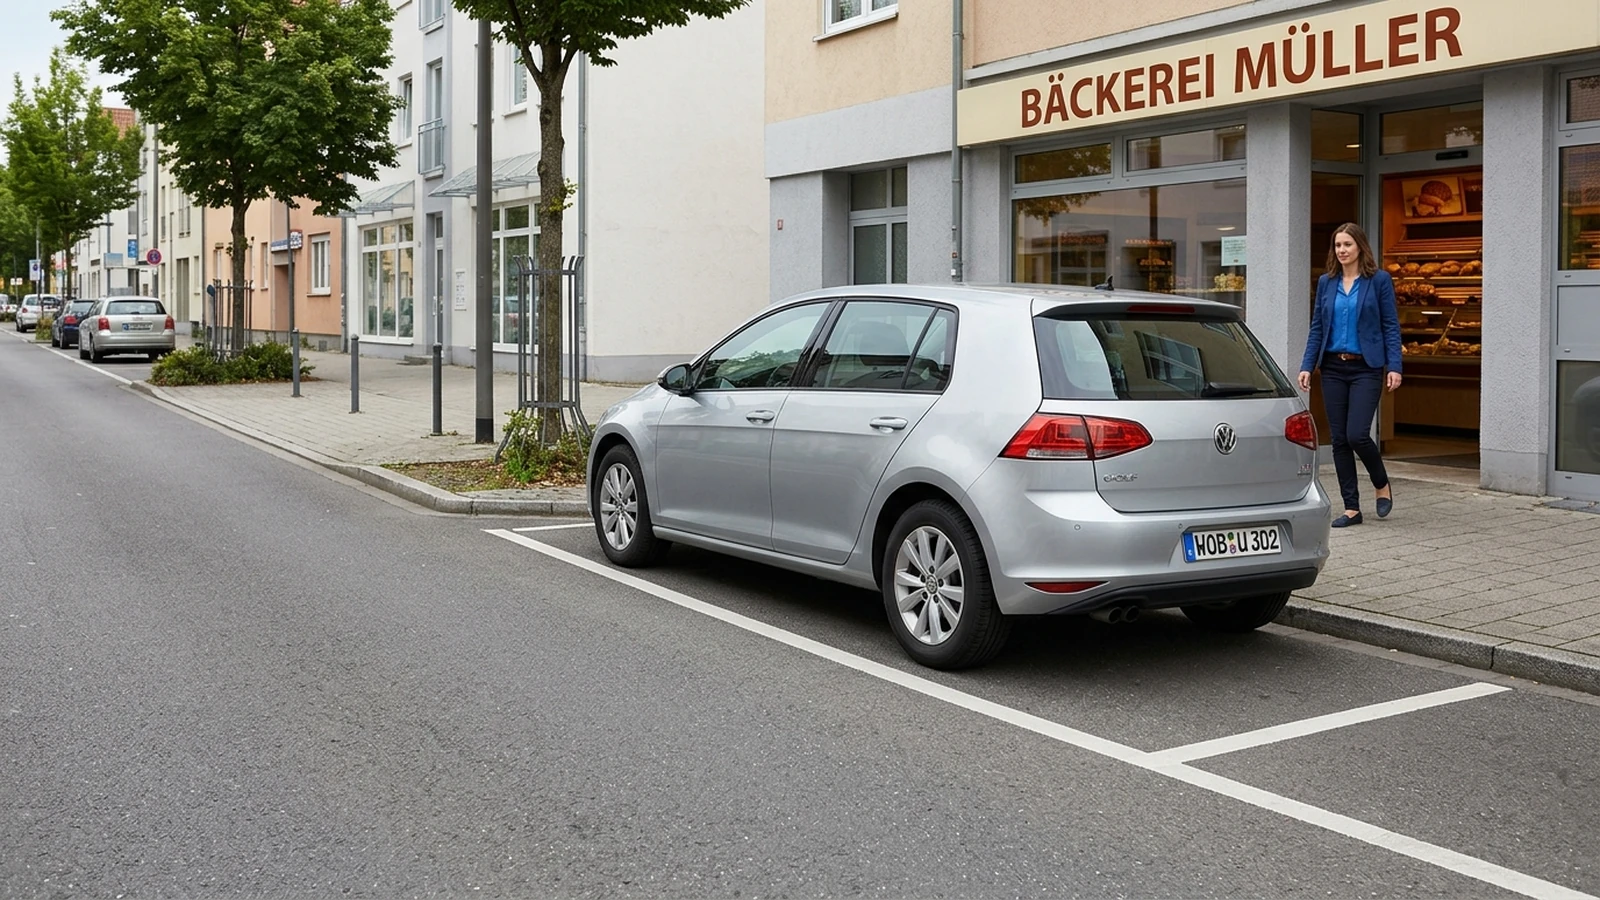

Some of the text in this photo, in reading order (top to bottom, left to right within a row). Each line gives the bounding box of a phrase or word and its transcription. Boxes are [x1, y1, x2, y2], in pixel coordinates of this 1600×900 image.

[1021, 7, 1463, 128] BÄCKEREI MÜLLER
[1214, 424, 1237, 454] VW
[1250, 529, 1280, 551] 302
